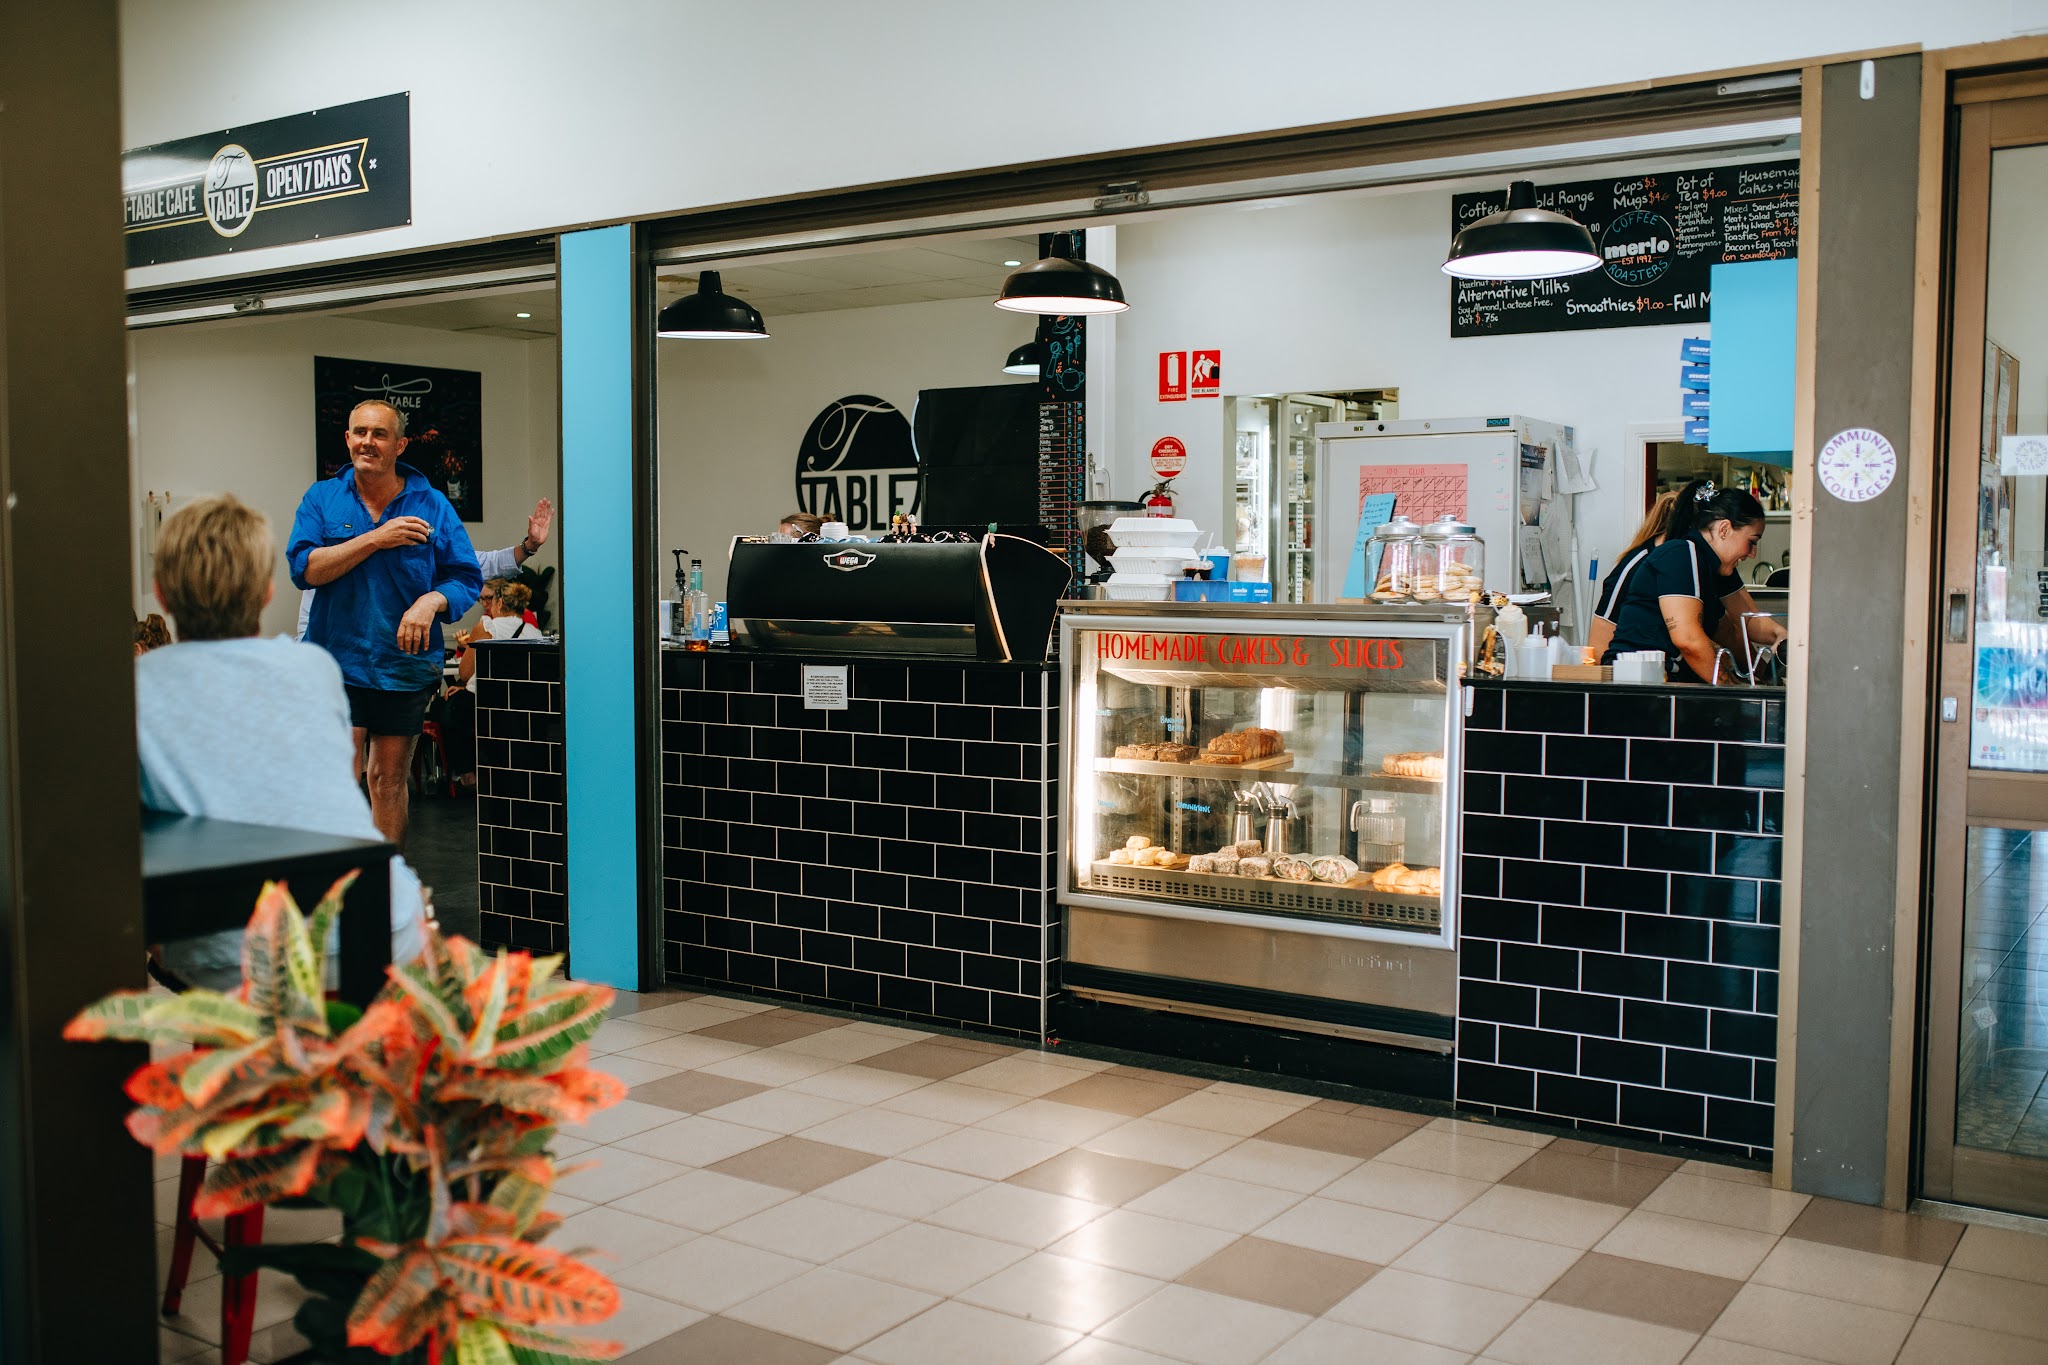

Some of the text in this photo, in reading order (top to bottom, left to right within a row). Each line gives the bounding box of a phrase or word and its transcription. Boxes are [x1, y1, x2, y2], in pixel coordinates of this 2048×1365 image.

[266, 153, 352, 198] OPEN 7 DAYS
[1677, 172, 1714, 192] Pot of
[1739, 169, 1800, 183] Housema
[1614, 181, 1643, 195] Cups
[1739, 183, 1773, 195] Cakes
[1783, 179, 1800, 189] Sli
[166, 185, 197, 216] CAFE
[1613, 195, 1648, 209] Mugs
[1679, 188, 1727, 202] Tea $4.00
[207, 184, 254, 222] TABLE
[1459, 190, 1595, 219] Coffee old Range
[1678, 202, 1692, 211] Earl
[1724, 199, 1800, 214] Mixed Sandwiches
[1612, 211, 1660, 233] COFFEE
[1724, 214, 1742, 223] Meat
[1748, 212, 1770, 221] Salad
[1751, 221, 1775, 230] Wraps
[1761, 230, 1781, 238] From
[1604, 236, 1670, 259] merlo
[1725, 242, 1750, 252] Bacon
[1755, 240, 1770, 252] Egg
[1772, 237, 1799, 248] Toasti
[1622, 255, 1653, 265] EST 1992
[1608, 260, 1669, 282] ROASTERS
[1458, 279, 1570, 304] Alternative Milks
[1502, 300, 1532, 310] Lactose
[1566, 297, 1635, 315] Smoothies
[1636, 296, 1664, 313] $9.00
[1674, 293, 1696, 312] Full
[1458, 315, 1474, 325] Oat
[389, 396, 421, 408] TABLE
[1821, 430, 1895, 466] COMMUNITY
[1409, 467, 1425, 476] CLUB
[1824, 473, 1891, 501] COLLEGES
[801, 474, 918, 531] TABLE
[1097, 633, 1403, 670] HOMEMADE CAKES & SLICES
